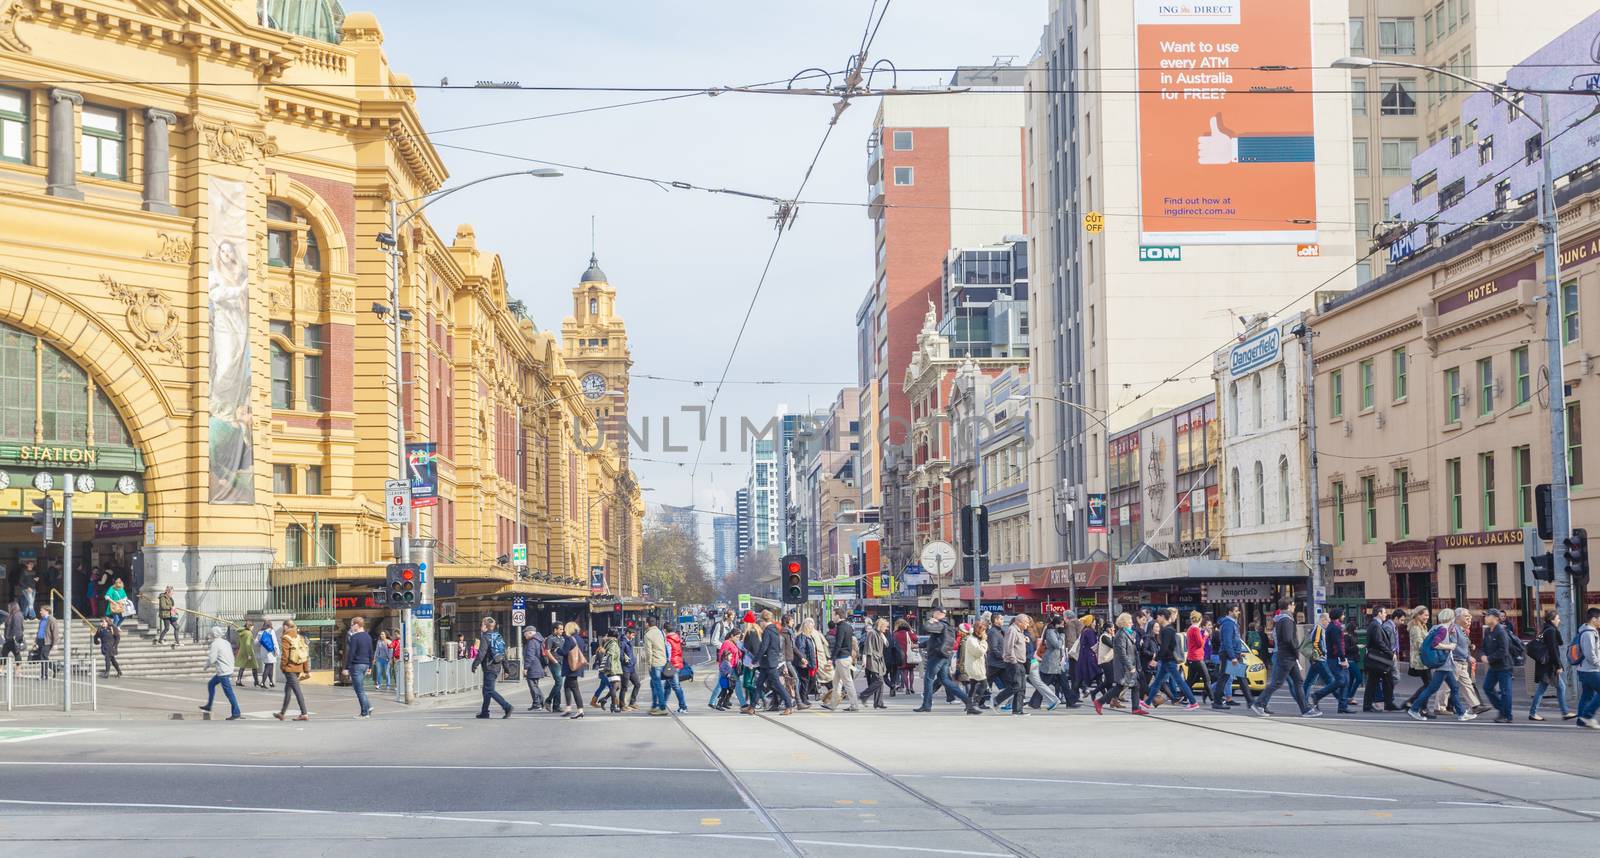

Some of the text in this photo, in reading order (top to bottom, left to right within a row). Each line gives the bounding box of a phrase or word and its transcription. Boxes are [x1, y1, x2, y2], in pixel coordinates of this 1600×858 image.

[1159, 6, 1233, 14] ING DIRECT
[1160, 41, 1239, 53] Want to use
[1160, 57, 1229, 70] every ATM
[1161, 72, 1233, 84] in Australia
[1161, 88, 1227, 100] for FREE?
[1164, 208, 1236, 216] ingdirect.com.au
[1391, 232, 1414, 261] APN
[1558, 246, 1587, 267] OUNG
[1467, 281, 1498, 302] HOTEL
[1232, 334, 1277, 366] Dangerfield
[21, 446, 95, 463] STATION
[1445, 535, 1475, 546] YOUNG
[1485, 530, 1524, 544] JACKSO
